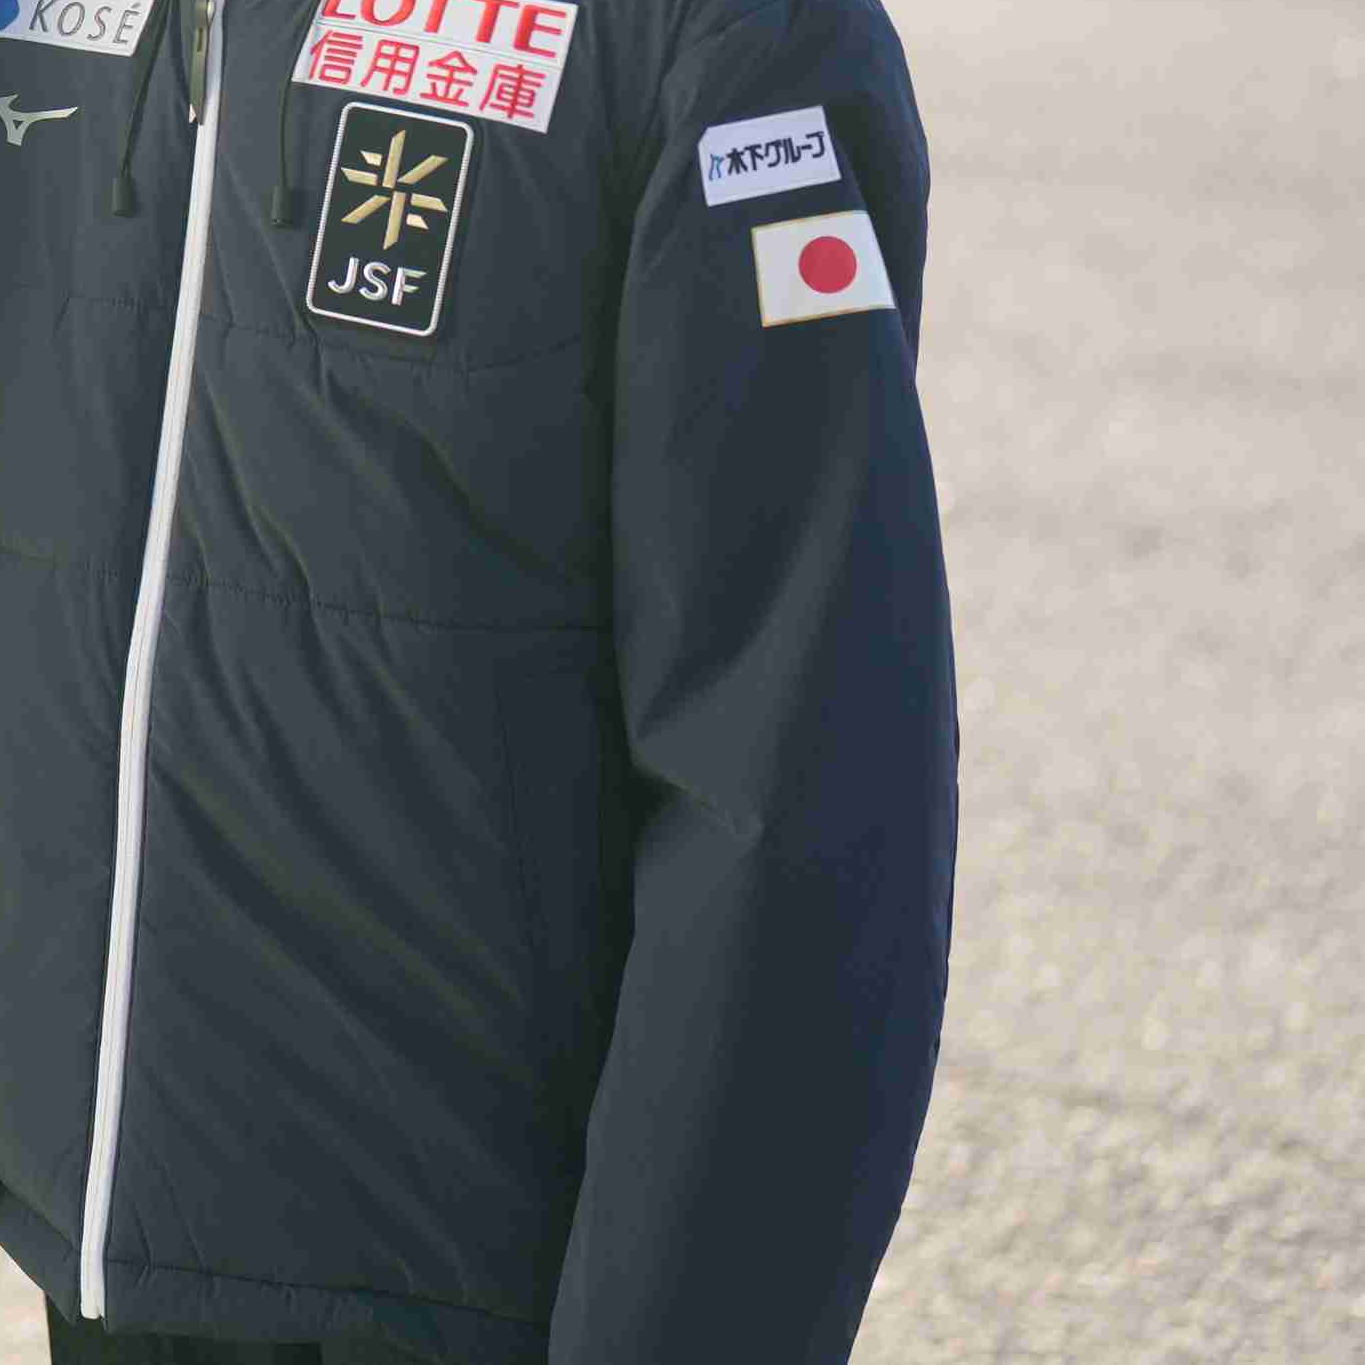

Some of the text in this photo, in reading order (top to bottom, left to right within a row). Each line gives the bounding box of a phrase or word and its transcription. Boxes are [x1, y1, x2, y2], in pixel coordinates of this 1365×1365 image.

[308, 29, 547, 120] 信用金庫
[327, 257, 428, 307] JSF
